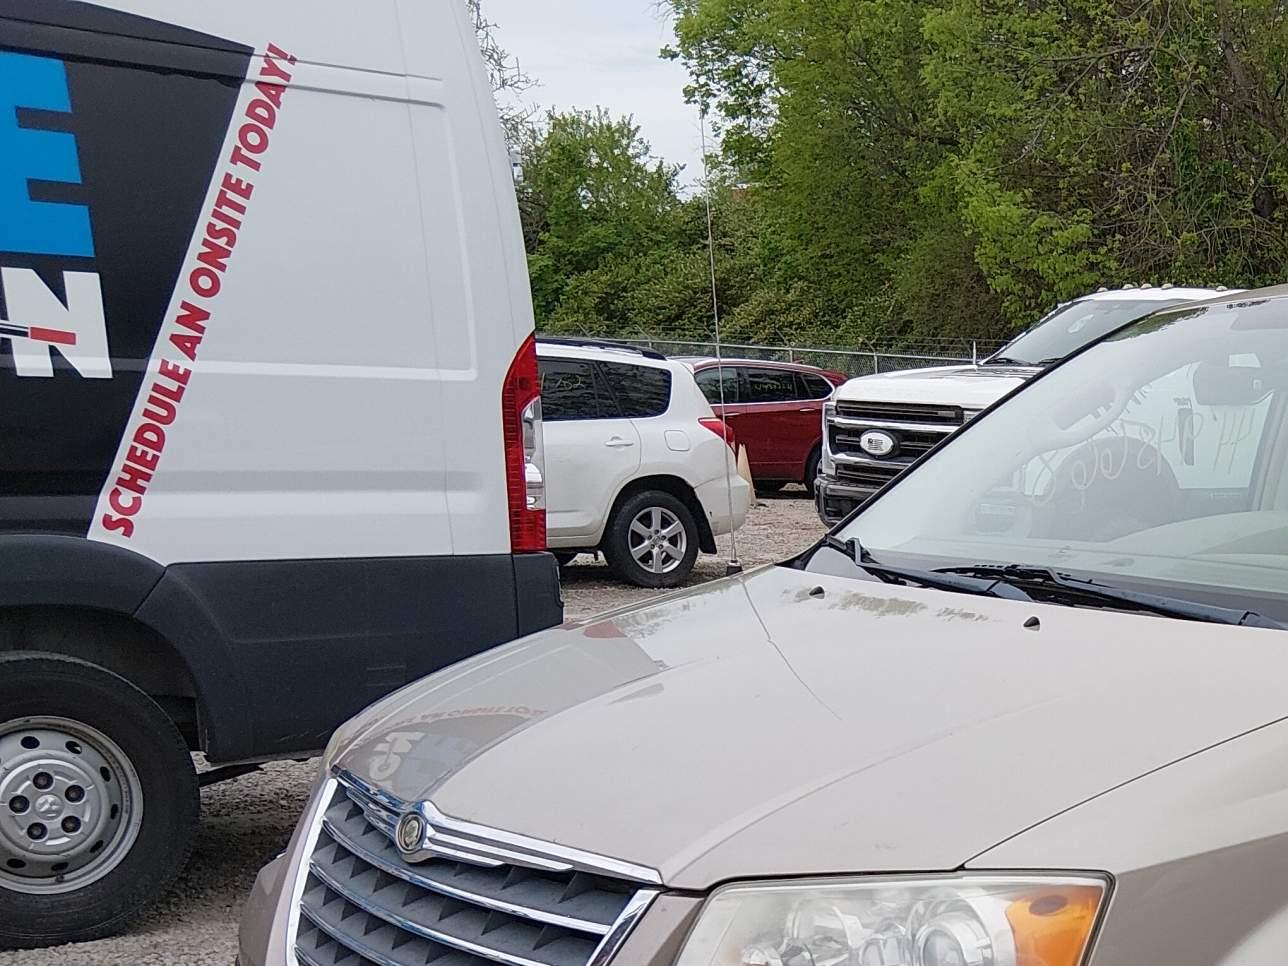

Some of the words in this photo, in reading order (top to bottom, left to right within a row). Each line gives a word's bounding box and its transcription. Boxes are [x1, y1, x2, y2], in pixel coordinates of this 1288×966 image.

[229, 42, 298, 172] TODAY!
[189, 172, 254, 298] ONSITE
[169, 300, 211, 362] AN
[102, 359, 192, 538] SCHEDULE
